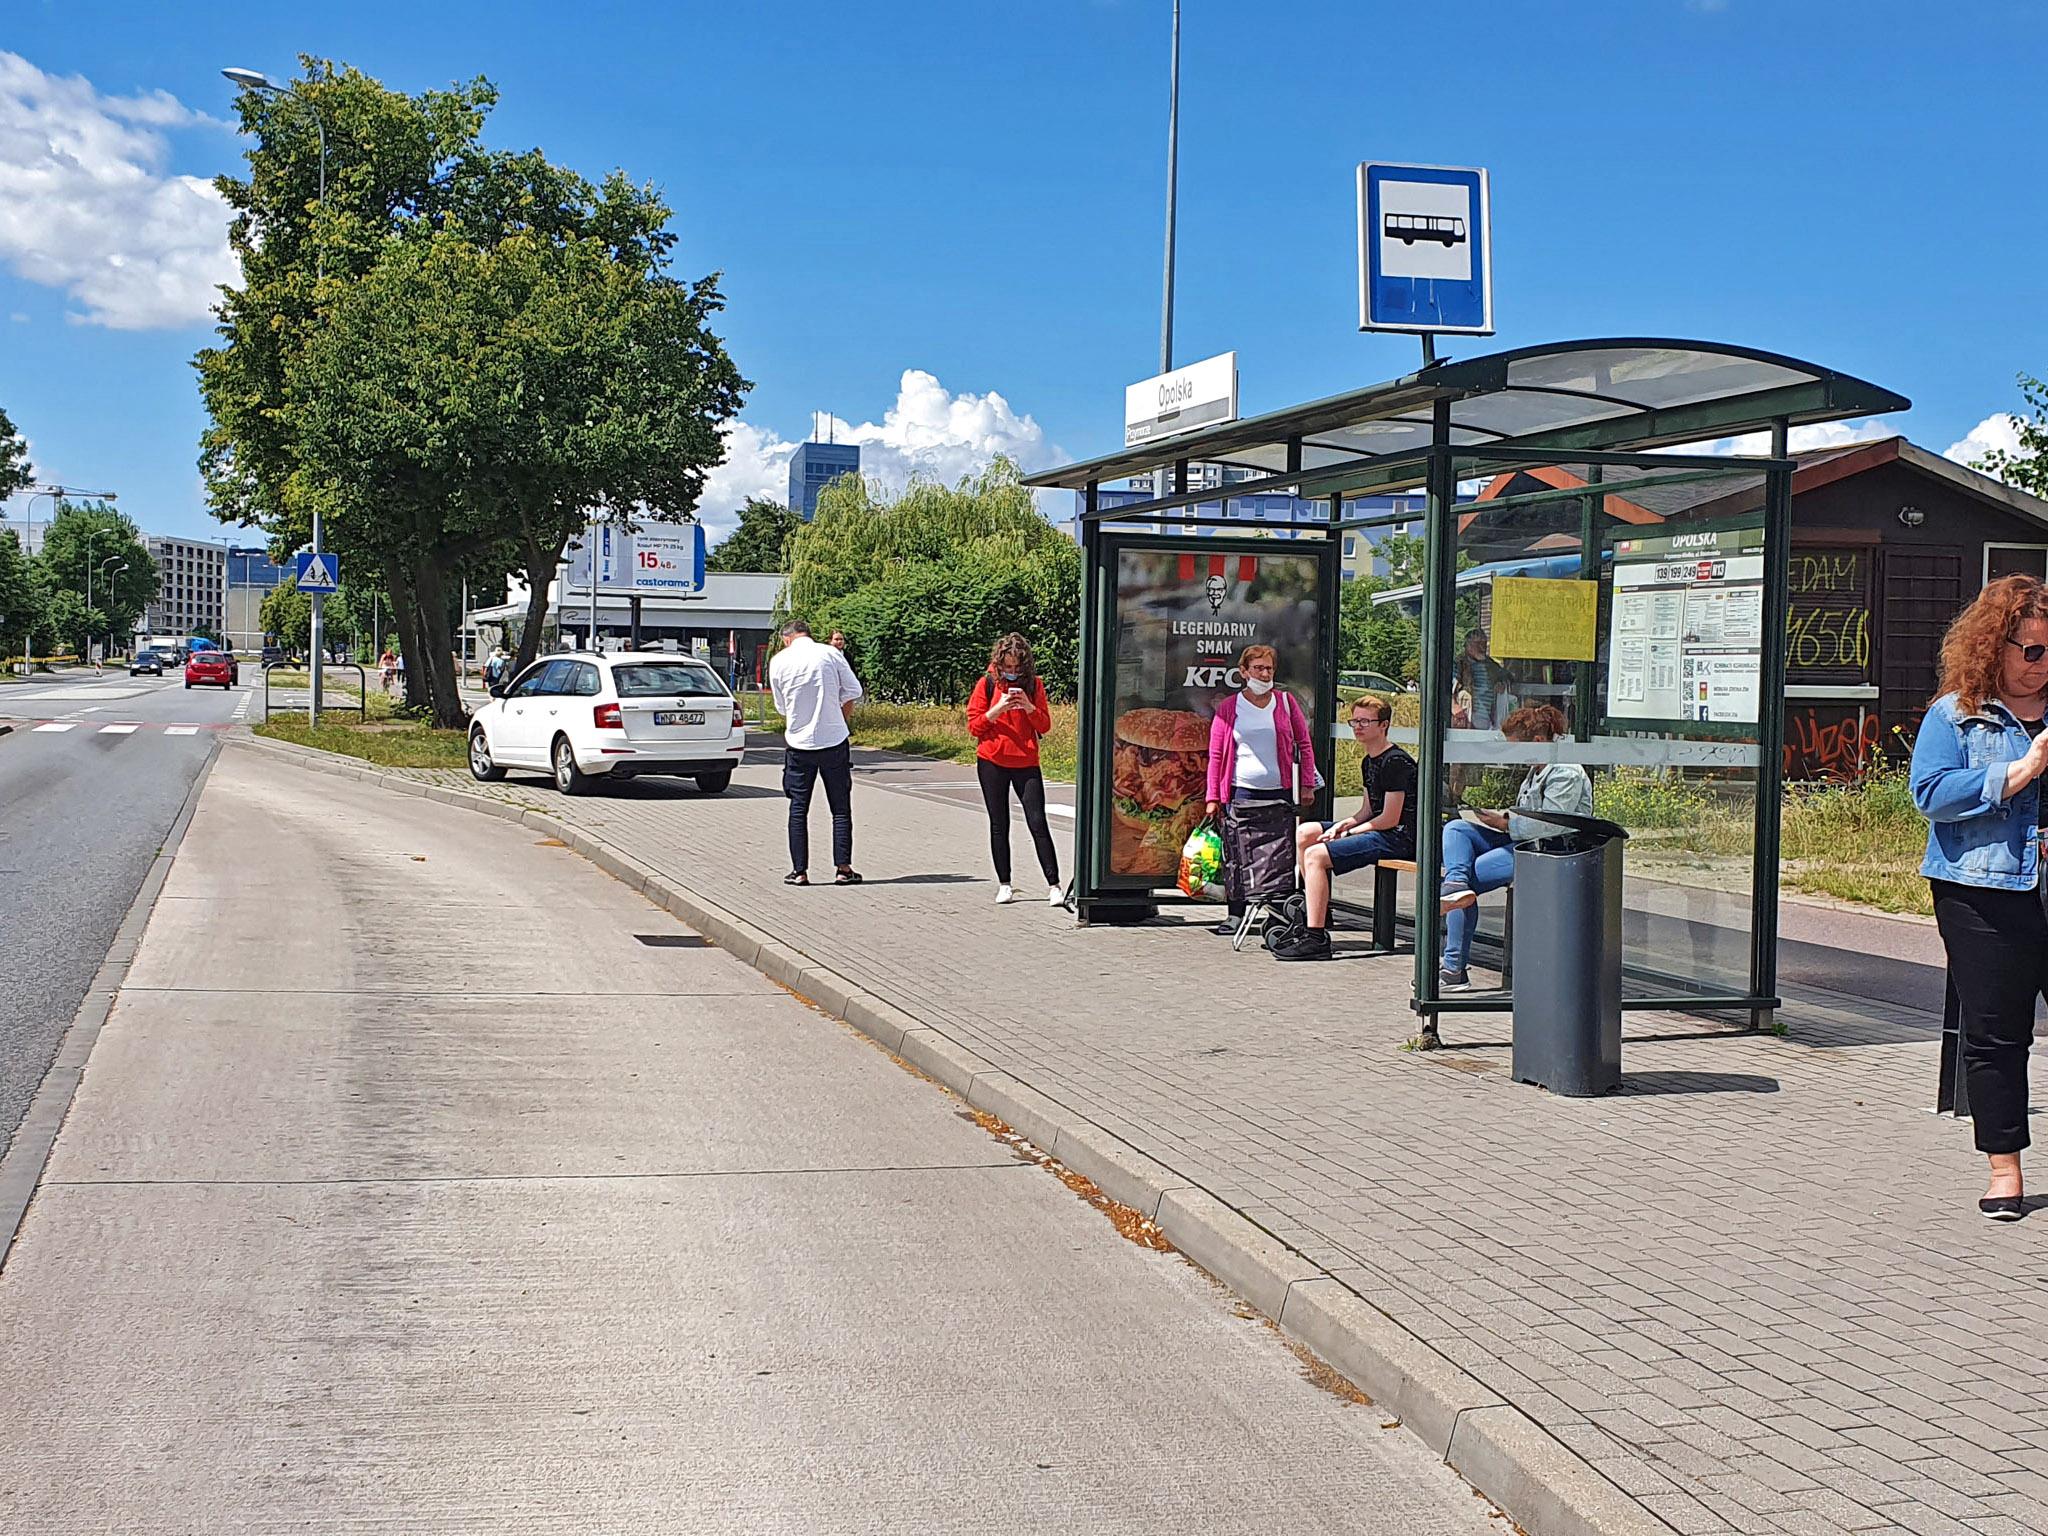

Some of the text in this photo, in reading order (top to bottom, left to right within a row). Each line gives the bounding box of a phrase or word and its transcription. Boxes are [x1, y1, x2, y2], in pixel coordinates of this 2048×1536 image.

[1158, 377, 1193, 411] Opolska
[1656, 567, 1668, 580] 139
[1670, 567, 1681, 578] 199
[1683, 566, 1696, 578] 249
[636, 578, 689, 587] castorama
[1172, 621, 1256, 637] LEGENDARNY
[1196, 640, 1232, 654] SMAK
[1183, 666, 1242, 688] KFC
[660, 713, 703, 724] WND 48477
